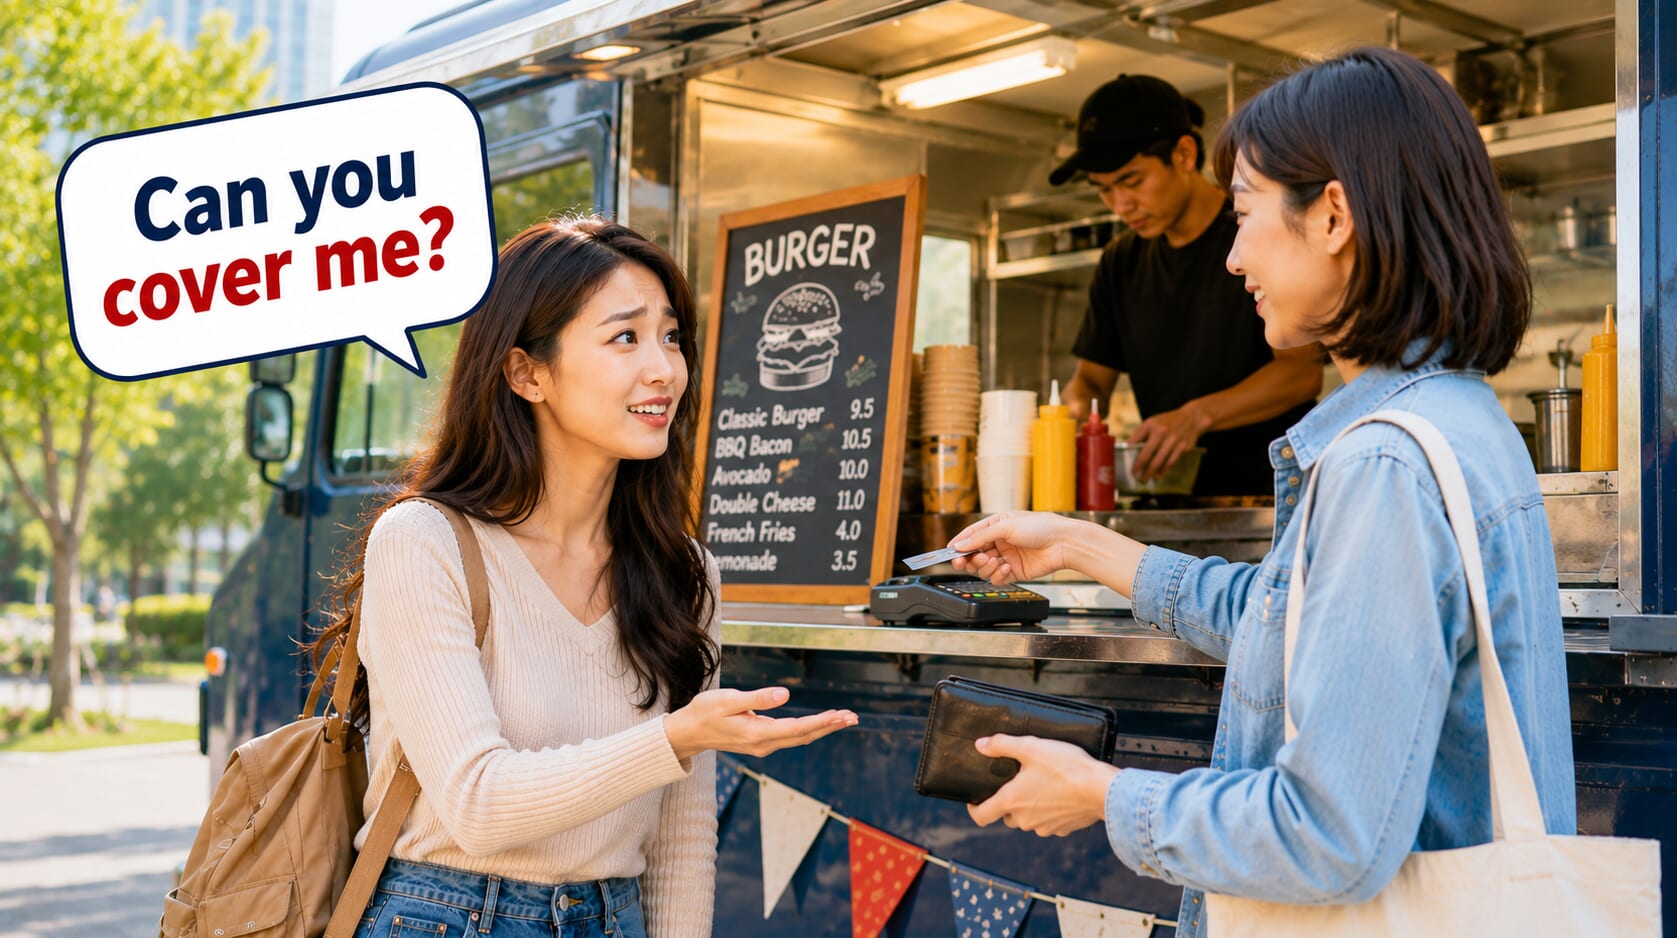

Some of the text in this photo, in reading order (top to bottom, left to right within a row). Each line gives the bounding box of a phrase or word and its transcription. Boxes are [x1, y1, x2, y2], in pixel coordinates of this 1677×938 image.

[744, 223, 877, 287] BURGER
[717, 397, 875, 431] Classic Burger 9.5
[714, 427, 873, 460] BBQ Bacon 10.5
[711, 458, 869, 487] Avocado 10.0
[709, 488, 866, 516] Double Cheese 11.0
[706, 519, 862, 544] French Fries 4.0
[715, 549, 858, 572] monade 3.5
